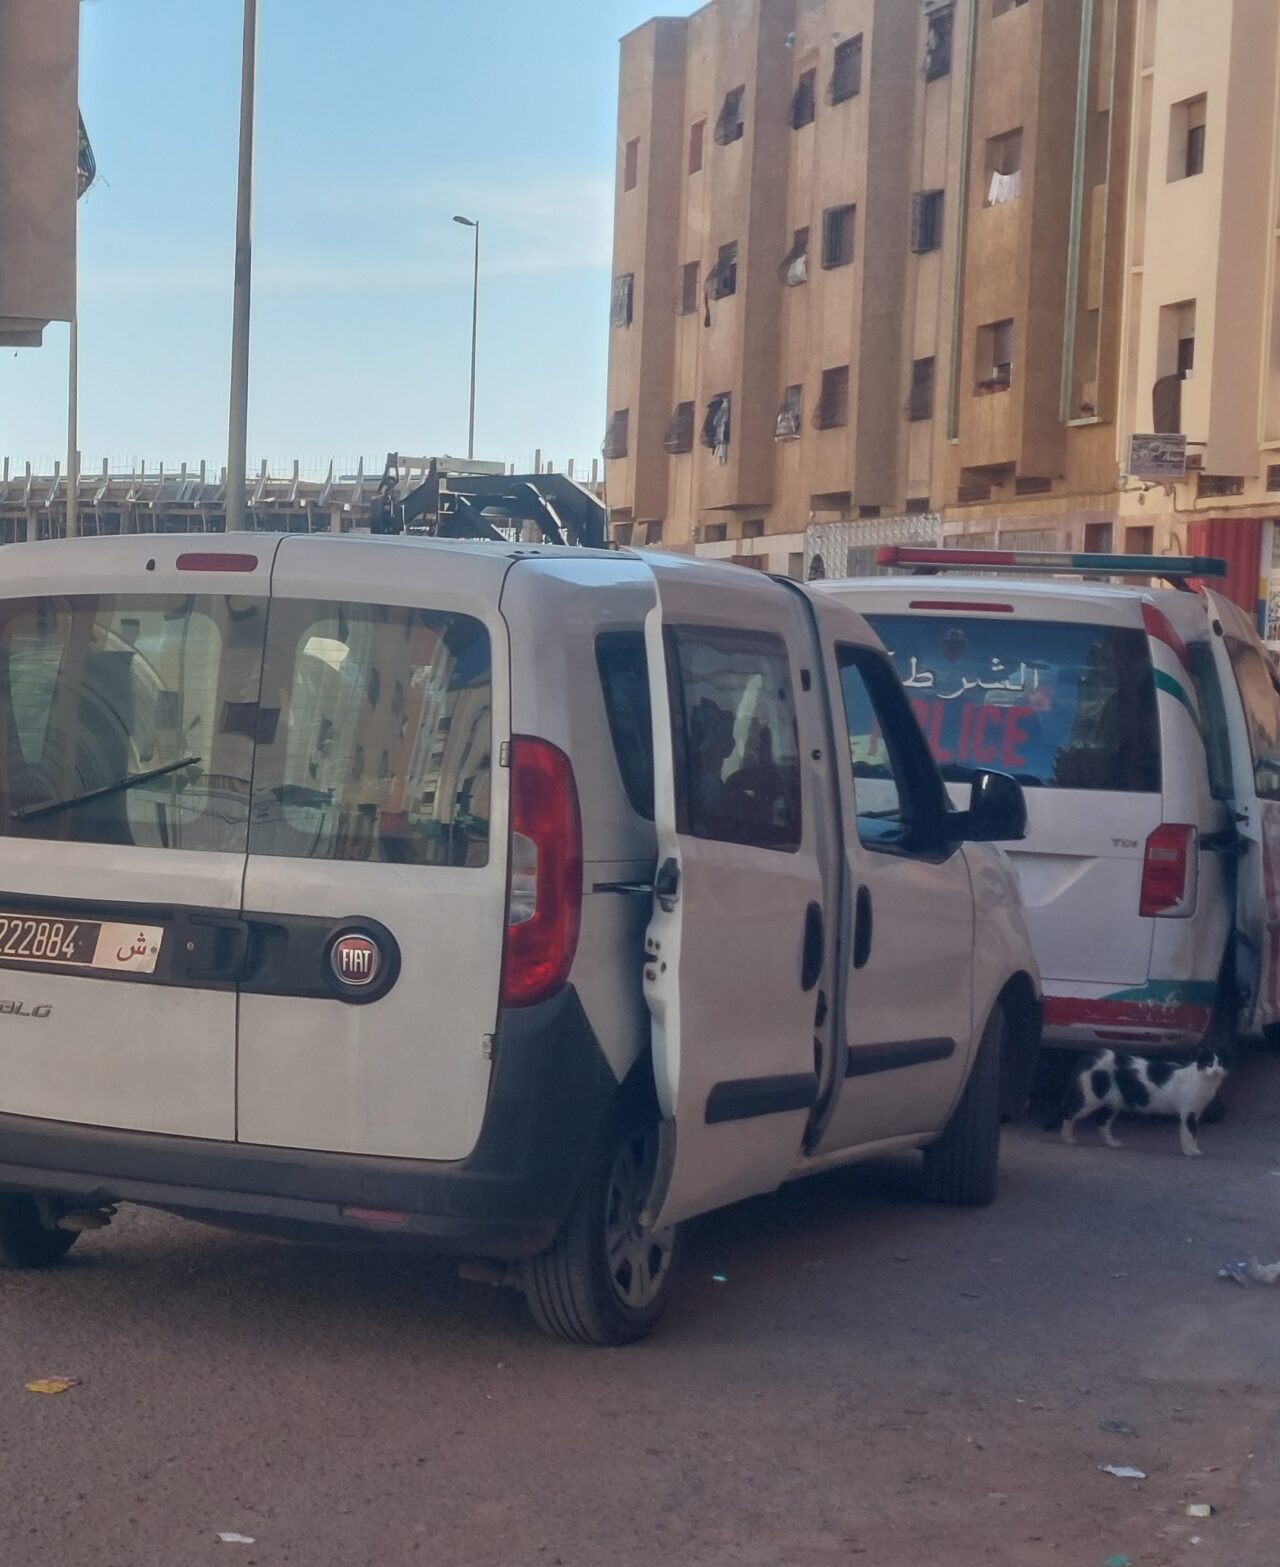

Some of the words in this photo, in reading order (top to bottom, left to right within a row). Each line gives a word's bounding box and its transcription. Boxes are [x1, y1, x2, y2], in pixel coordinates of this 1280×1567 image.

[888, 651, 1039, 699] الشرط
[116, 931, 147, 962] ش
[342, 948, 372, 973] FIAT
